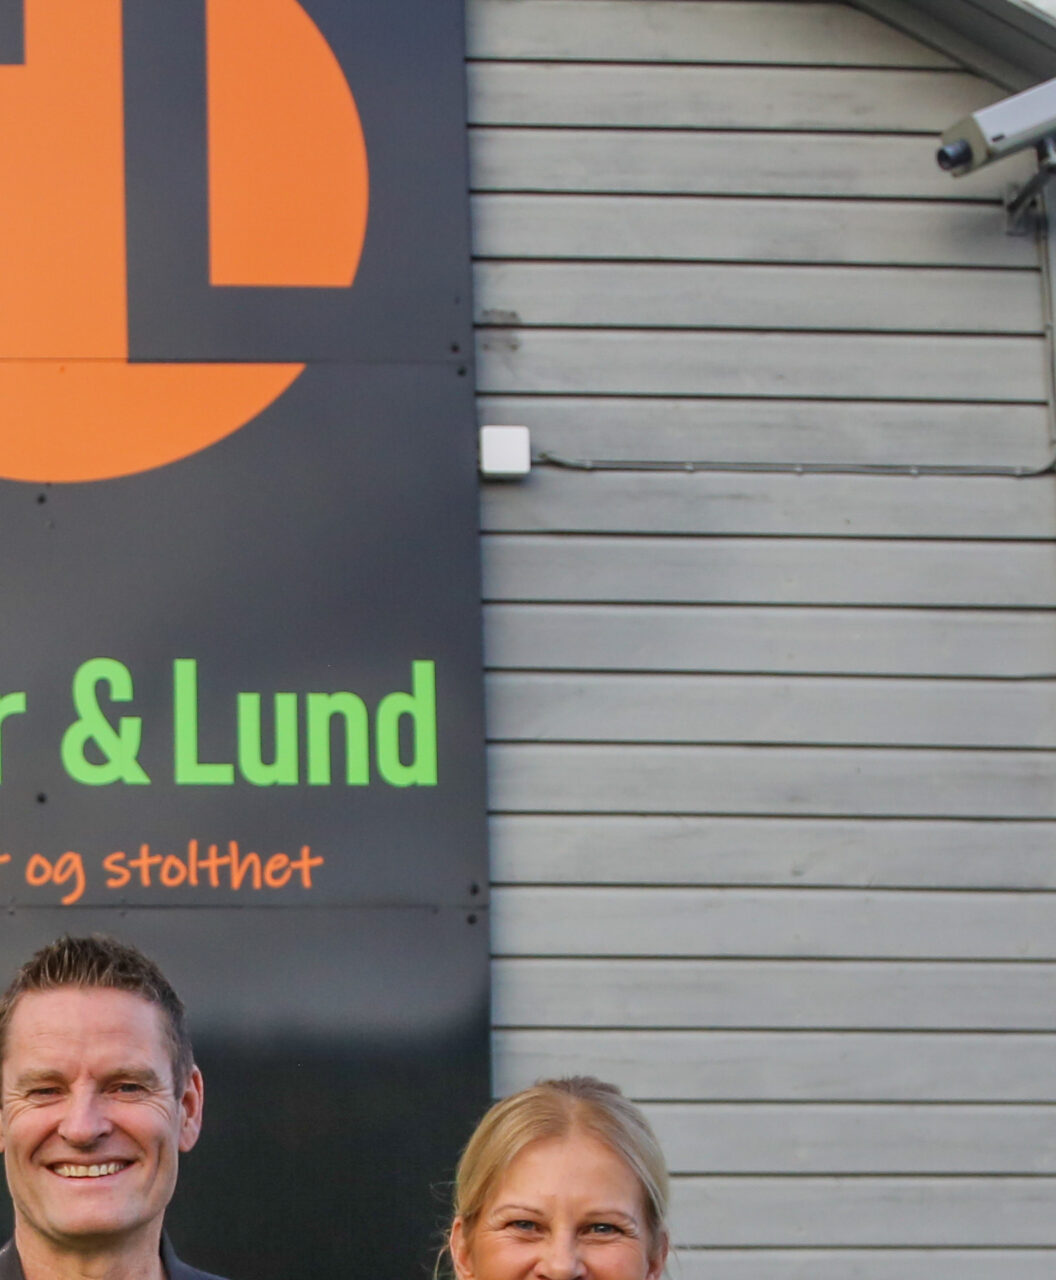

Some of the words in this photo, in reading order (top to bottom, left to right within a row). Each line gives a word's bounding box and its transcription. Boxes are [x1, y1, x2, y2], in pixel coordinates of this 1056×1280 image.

[60, 657, 151, 787] &
[173, 658, 439, 788] Lund
[24, 850, 87, 907] og
[101, 838, 325, 891] stolthet
